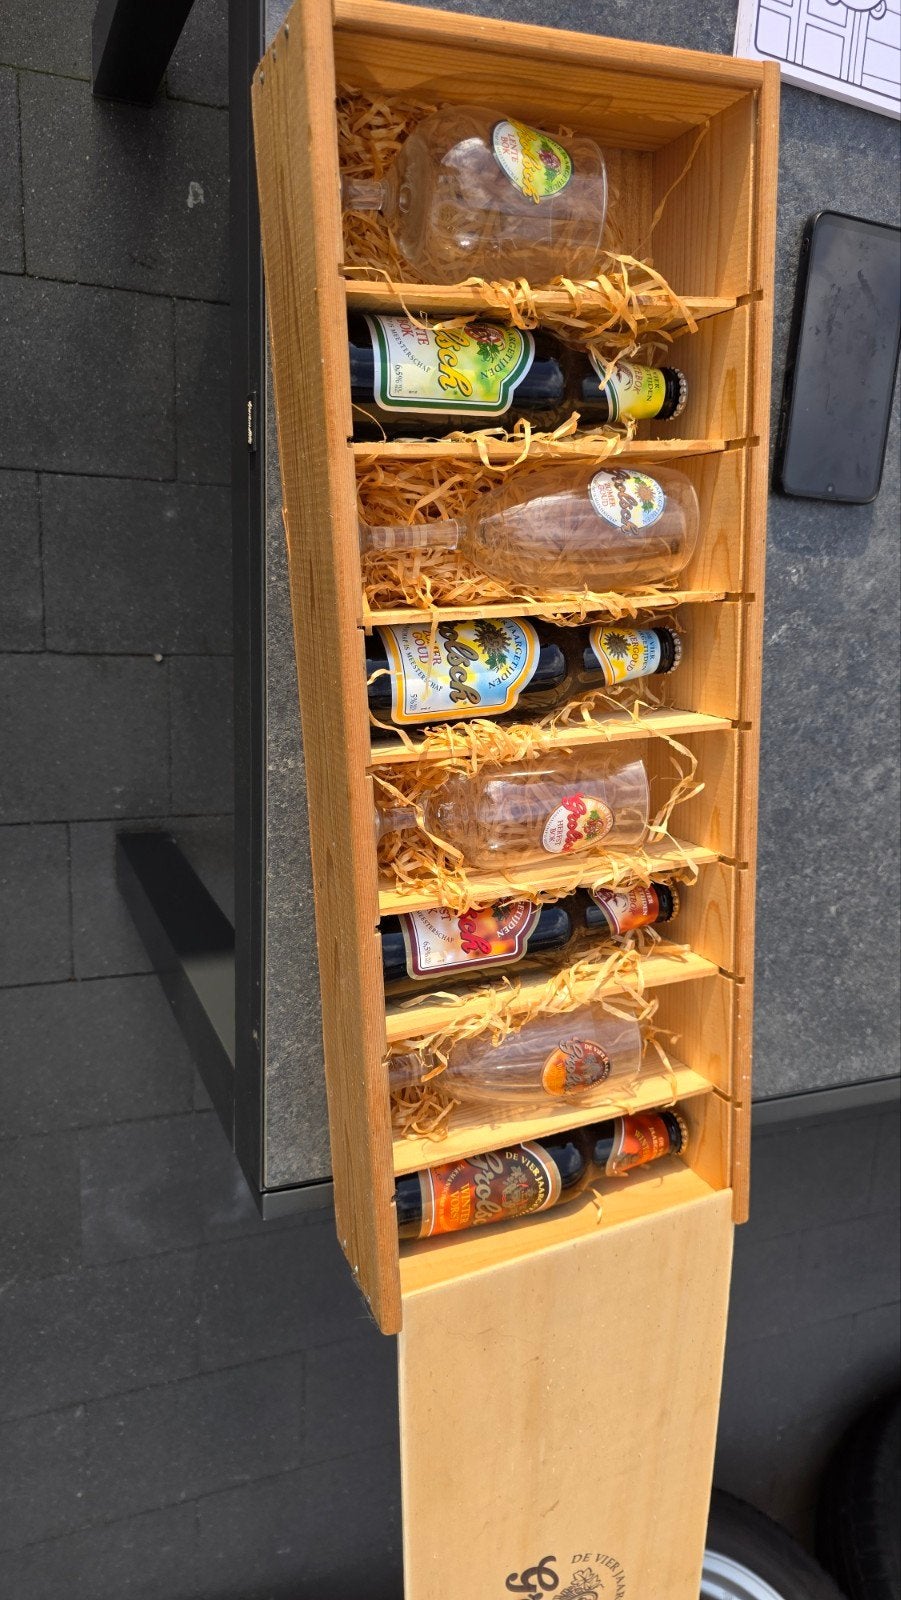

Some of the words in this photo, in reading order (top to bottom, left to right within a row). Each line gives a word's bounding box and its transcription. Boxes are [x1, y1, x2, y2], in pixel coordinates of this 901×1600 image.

[501, 136, 511, 156] BOK
[396, 319, 415, 338] BOK
[391, 329, 431, 373] MEESTERSCHAP
[433, 329, 473, 397] lsch
[412, 631, 429, 664] GOUD
[488, 624, 522, 689] JAARGETIJDEN
[584, 1043, 593, 1051] DE
[505, 1151, 519, 1161] DE
[522, 1155, 540, 1177] VIER
[450, 1190, 461, 1222] VORST
[460, 1182, 471, 1224] WINTER
[571, 1553, 592, 1564] DE
[595, 1553, 621, 1573] VIER
